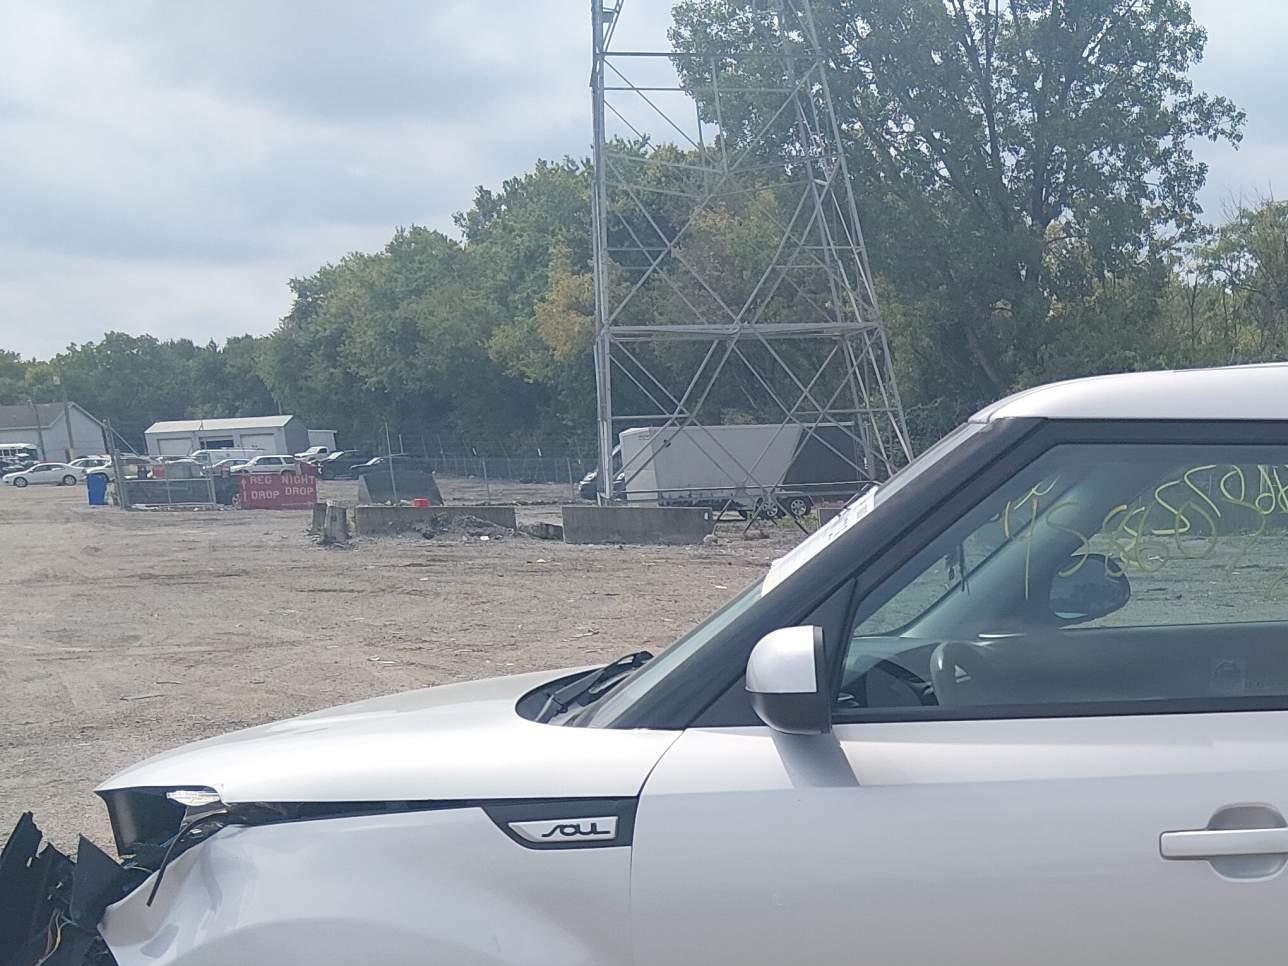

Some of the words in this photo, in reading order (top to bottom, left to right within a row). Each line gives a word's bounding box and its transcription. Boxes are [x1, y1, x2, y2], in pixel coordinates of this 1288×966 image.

[281, 474, 316, 485] NIGHT
[251, 490, 280, 500] DROP
[284, 487, 314, 496] DROP
[541, 822, 611, 838] SOUL
